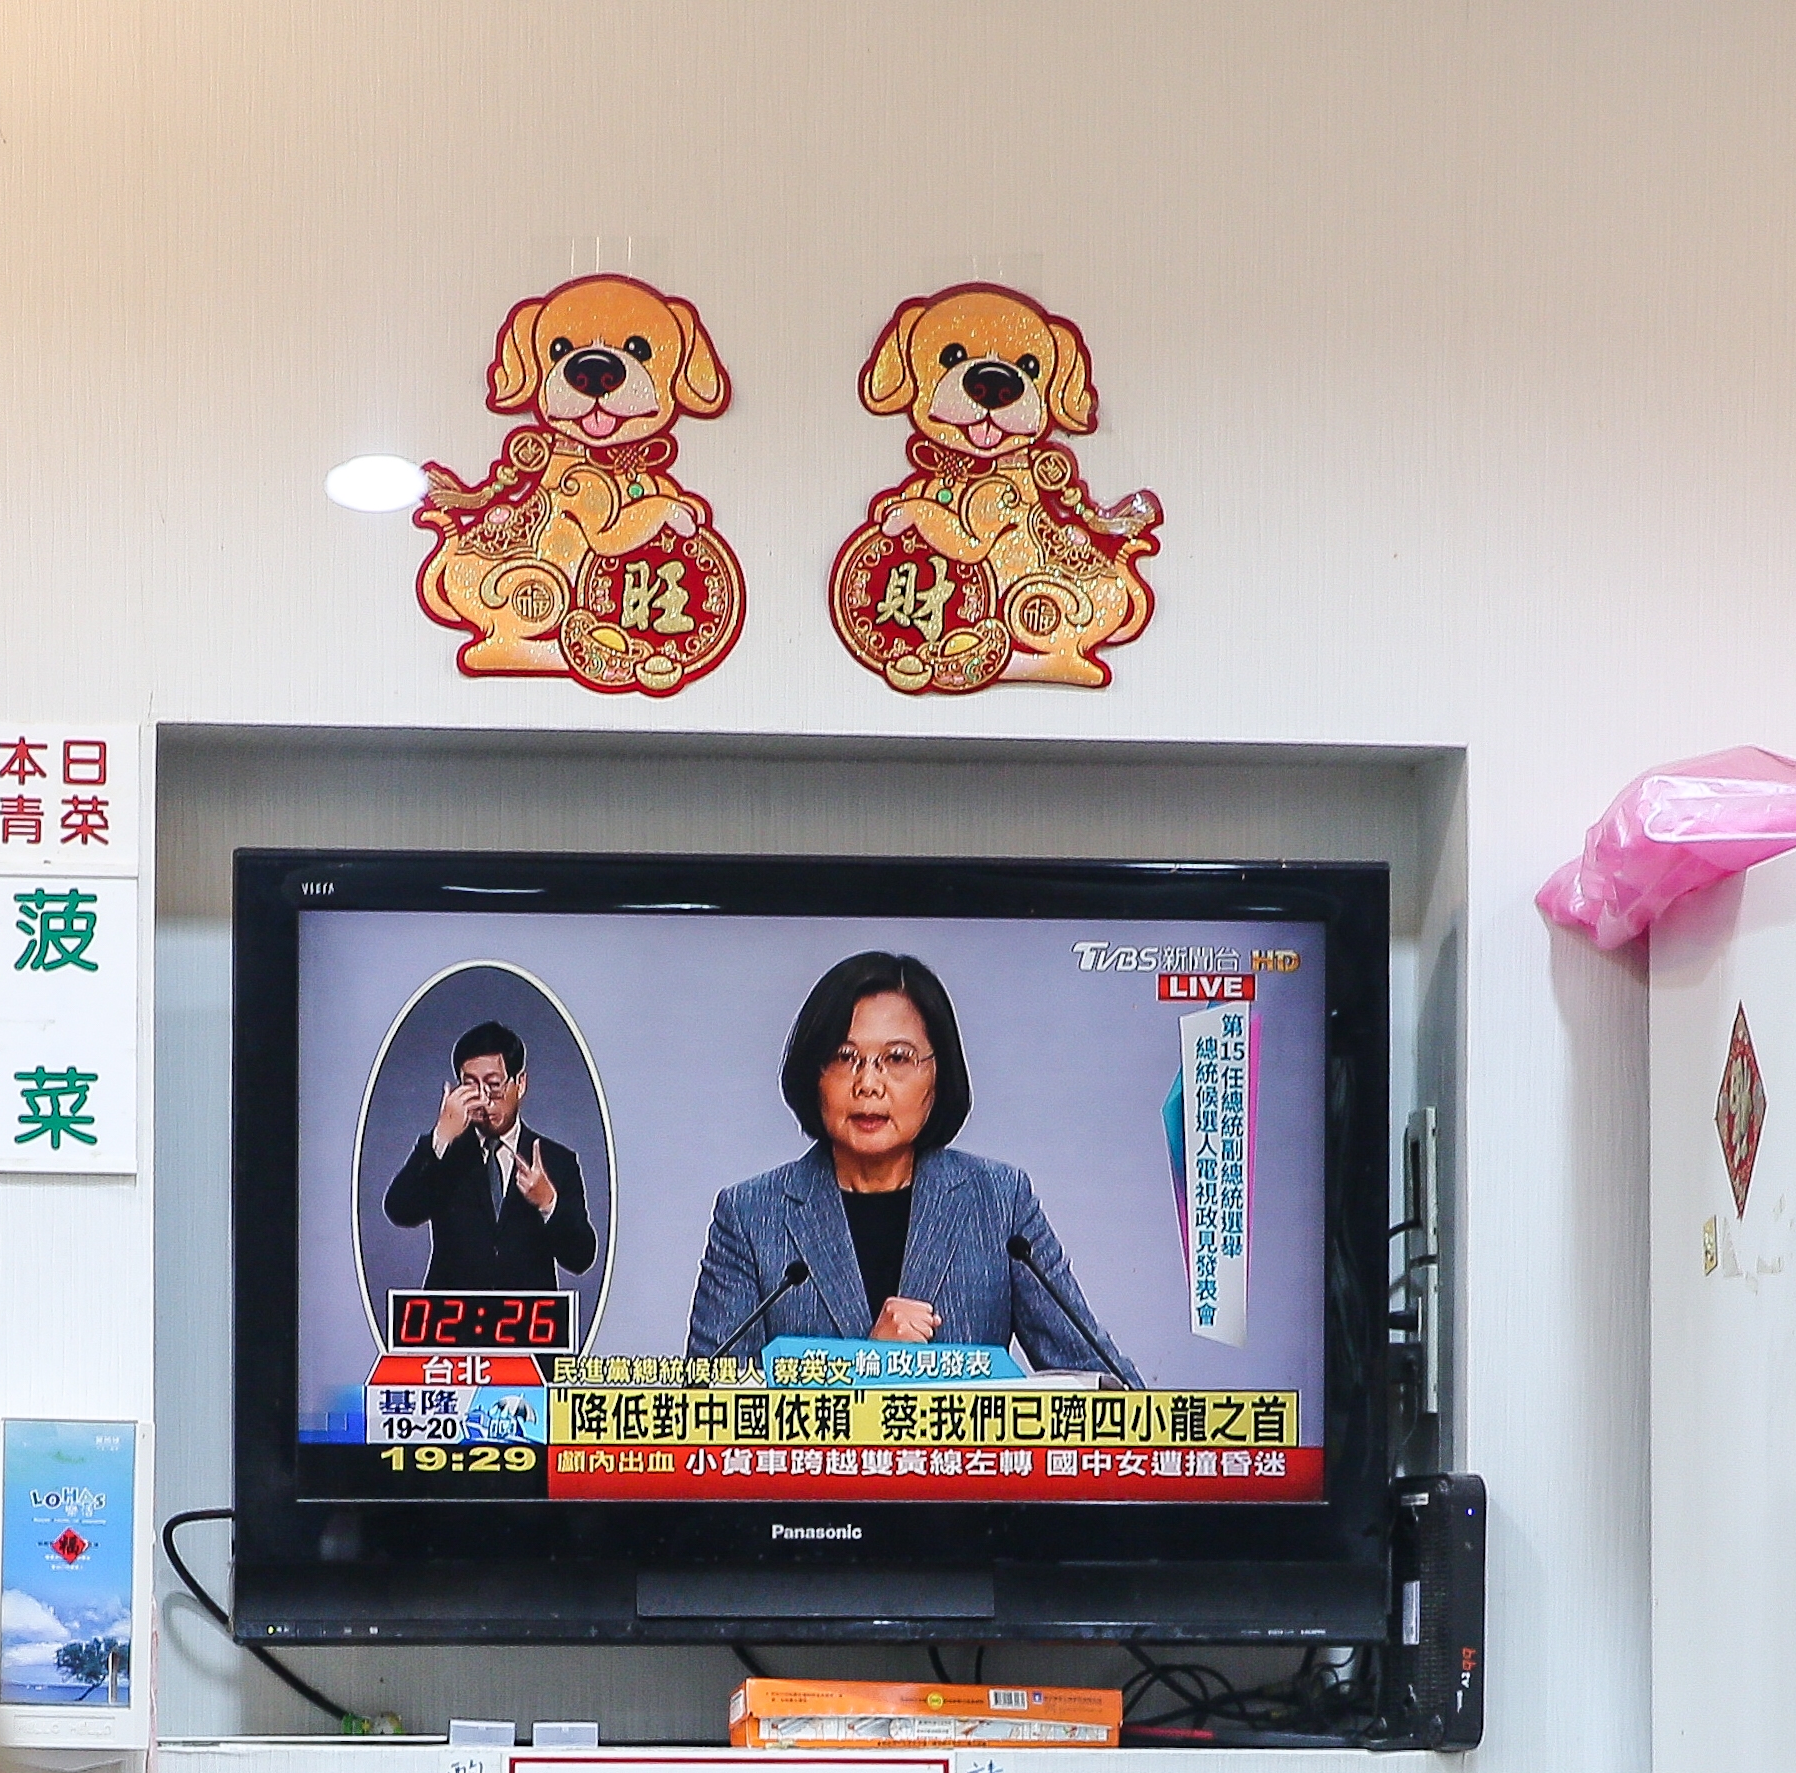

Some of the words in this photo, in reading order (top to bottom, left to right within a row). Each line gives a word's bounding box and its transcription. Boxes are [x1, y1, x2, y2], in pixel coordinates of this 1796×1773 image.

[620, 560, 695, 635] 旺
[875, 555, 956, 643] 財
[1251, 950, 1301, 972] HD
[1168, 976, 1243, 998] LIVE
[13, 887, 98, 1150] 菠菜
[1219, 1013, 1246, 1259] 第15任總統副總統選舉
[1195, 1035, 1218, 1327] 總統候選人電視政見發表會
[399, 1299, 556, 1344] 02:26
[421, 1356, 492, 1385] 台北
[553, 1356, 765, 1385] 民進黨總統候選人
[774, 1356, 854, 1385] 蔡英文
[378, 1389, 459, 1416] 基隆
[381, 1418, 458, 1439] 19~20
[379, 1446, 537, 1472] 19:29
[1046, 1450, 1287, 1478] 國中女遭撞昏迷
[30, 1487, 106, 1509] LOHAS
[771, 1524, 863, 1540] Panasonic
